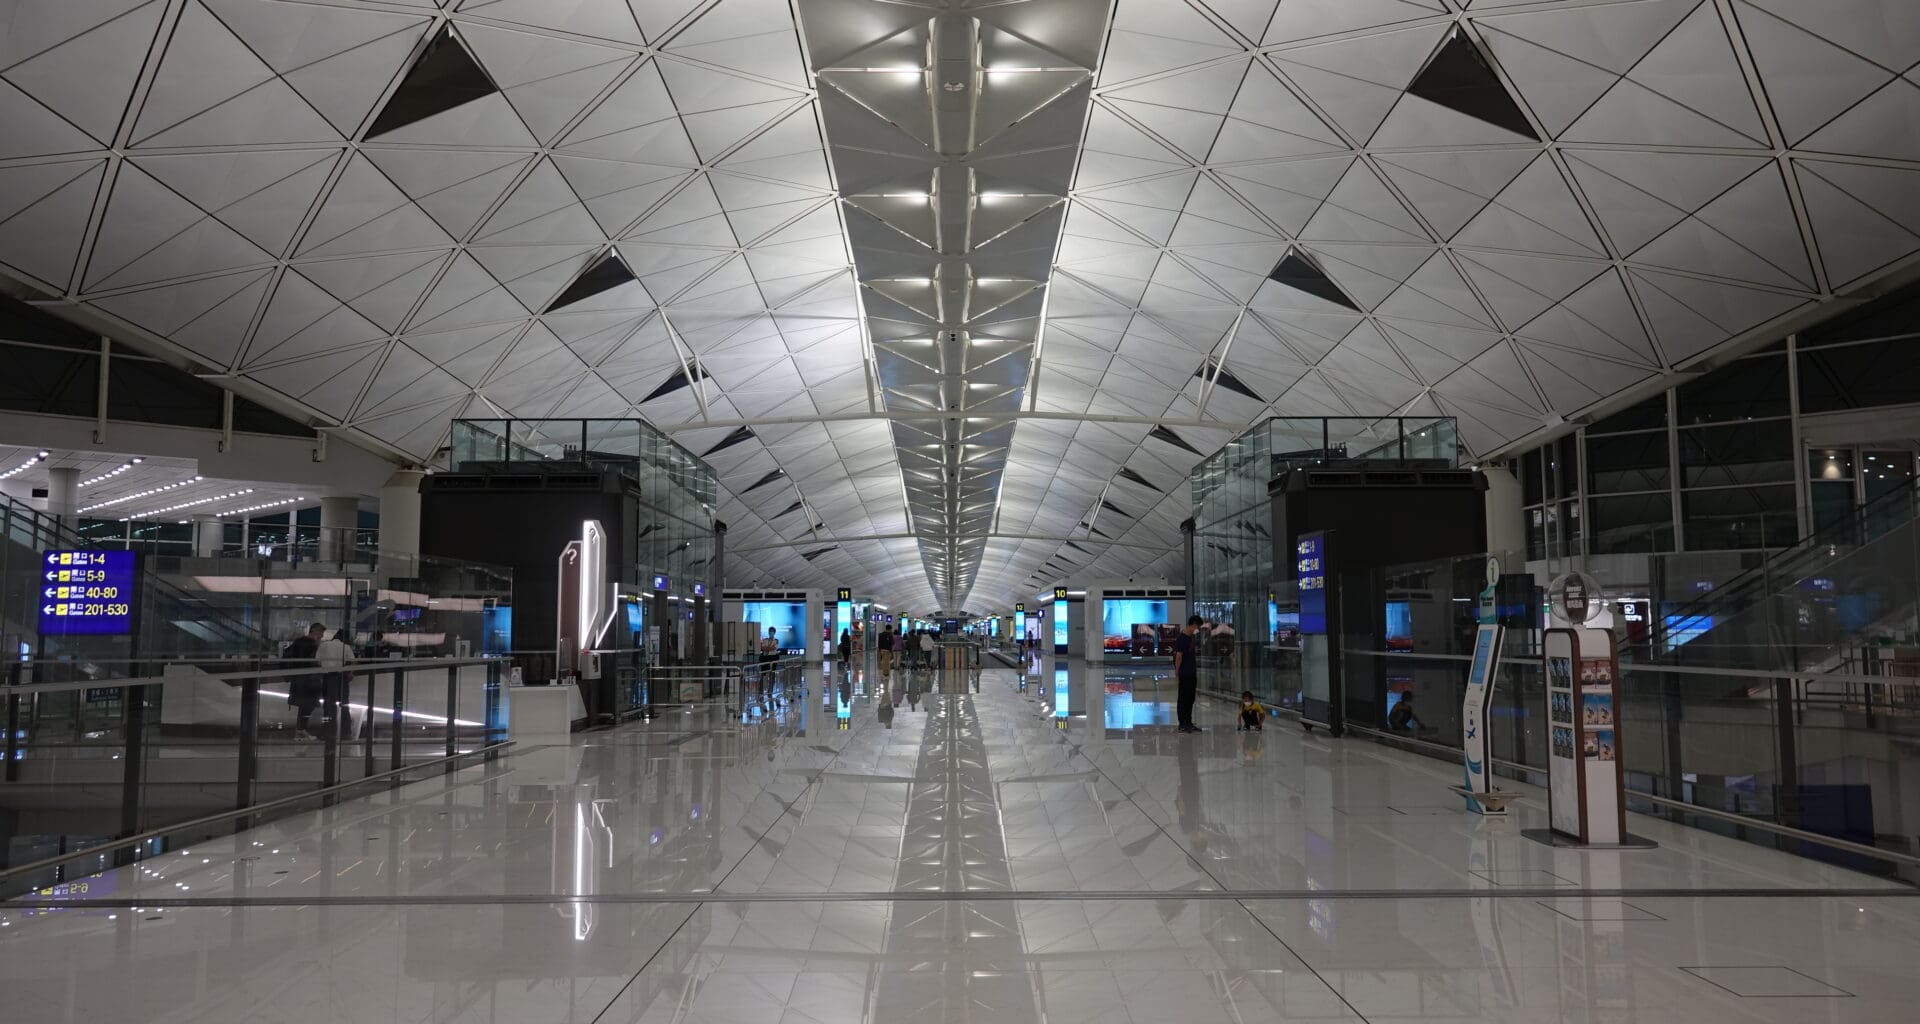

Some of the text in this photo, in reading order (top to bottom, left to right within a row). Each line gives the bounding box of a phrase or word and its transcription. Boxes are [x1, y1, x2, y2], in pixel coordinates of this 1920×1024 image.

[88, 553, 106, 565] 1-4
[87, 570, 105, 582] 5-9
[85, 586, 118, 599] 40-80
[839, 590, 849, 599] 11
[1055, 589, 1066, 598] 10
[84, 603, 129, 616] 201-530
